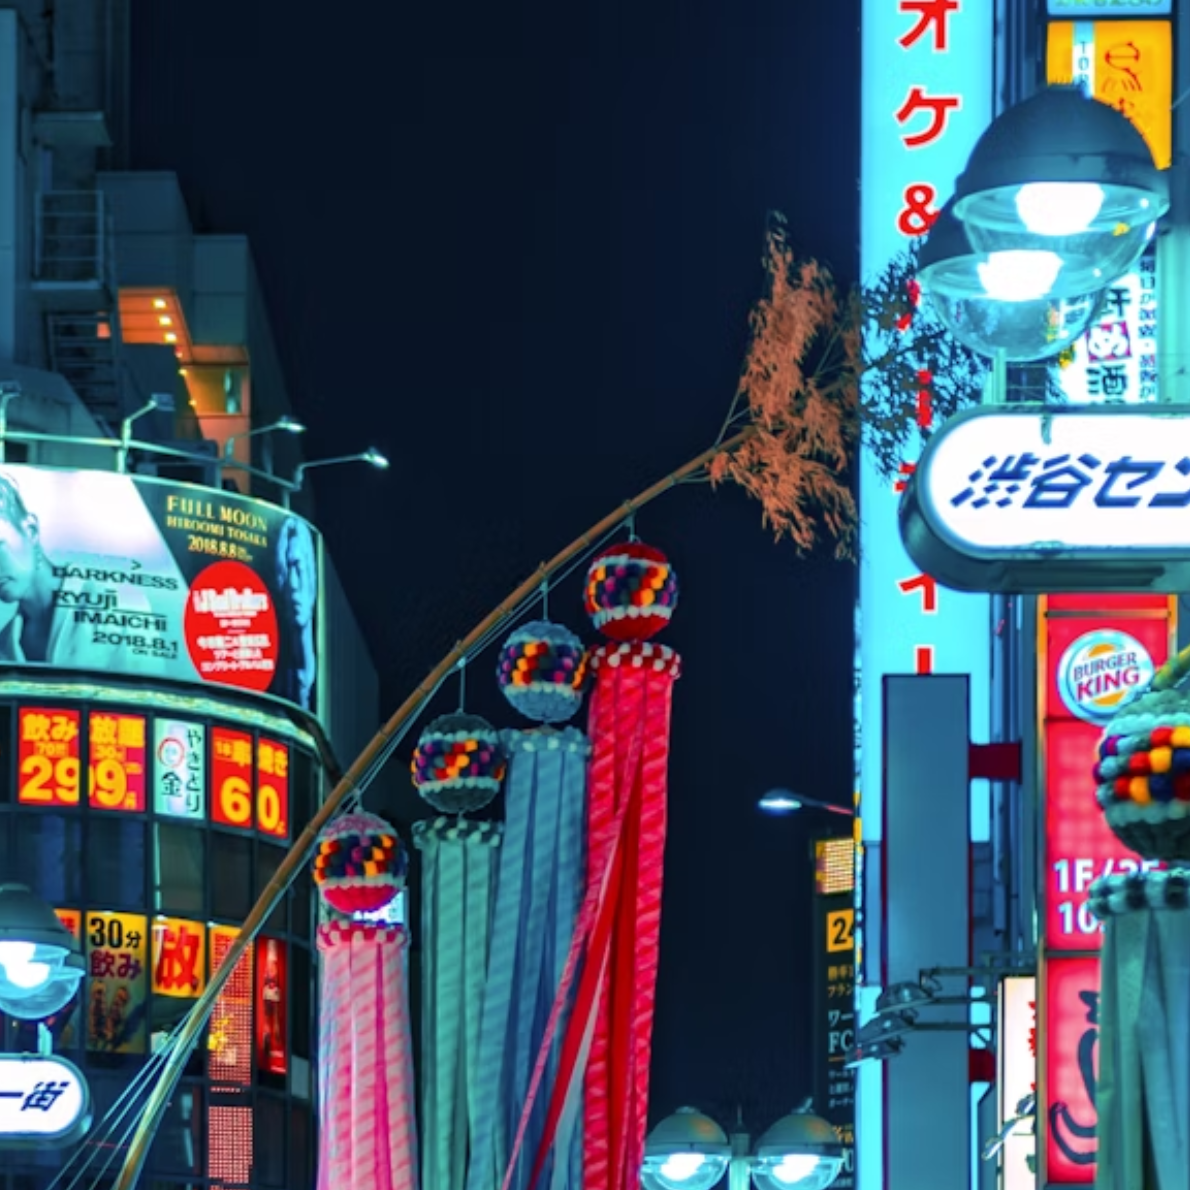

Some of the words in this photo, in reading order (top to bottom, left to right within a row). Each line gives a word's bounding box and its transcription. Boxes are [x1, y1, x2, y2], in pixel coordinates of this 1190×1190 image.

[167, 495, 215, 520] FULL
[220, 505, 268, 531] MOON
[1073, 651, 1139, 680] BURGER
[1076, 665, 1141, 702] KING
[90, 917, 142, 949] 30分
